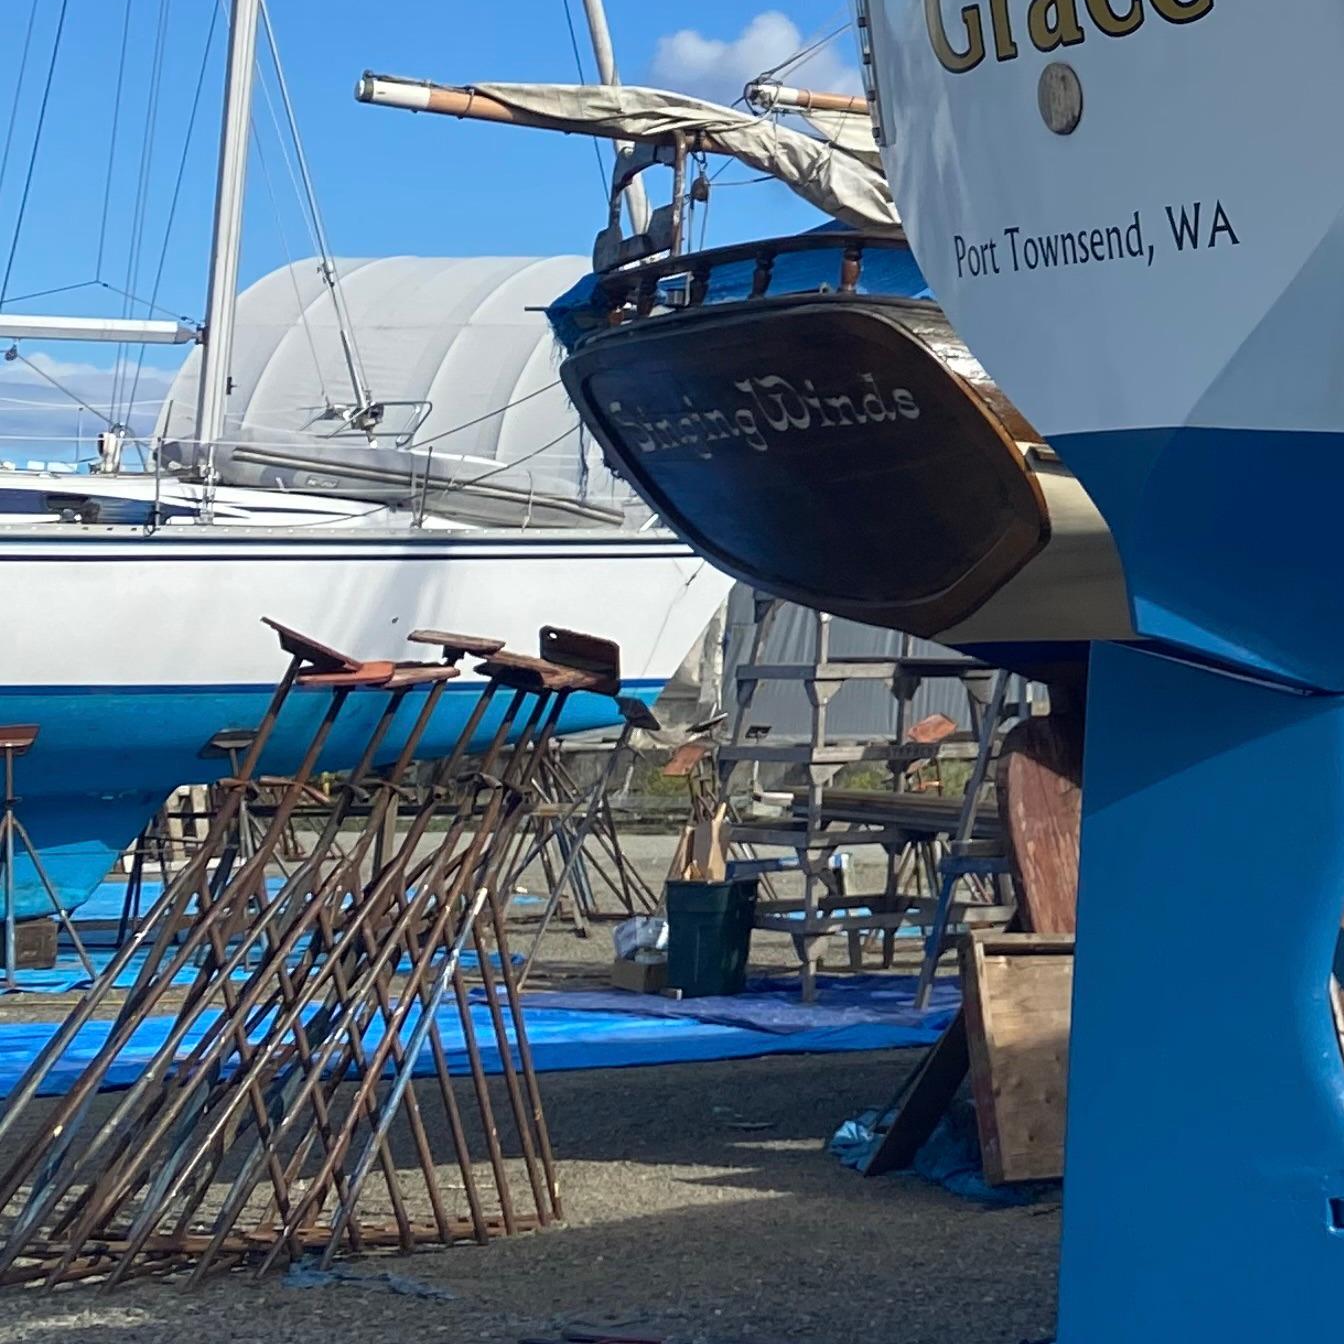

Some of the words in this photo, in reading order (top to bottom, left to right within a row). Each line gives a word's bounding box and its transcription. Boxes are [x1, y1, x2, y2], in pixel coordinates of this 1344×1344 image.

[953, 234, 1001, 278] Port
[1003, 210, 1155, 272] Townsend,
[1165, 199, 1241, 251] WA
[734, 372, 921, 433] Winds
